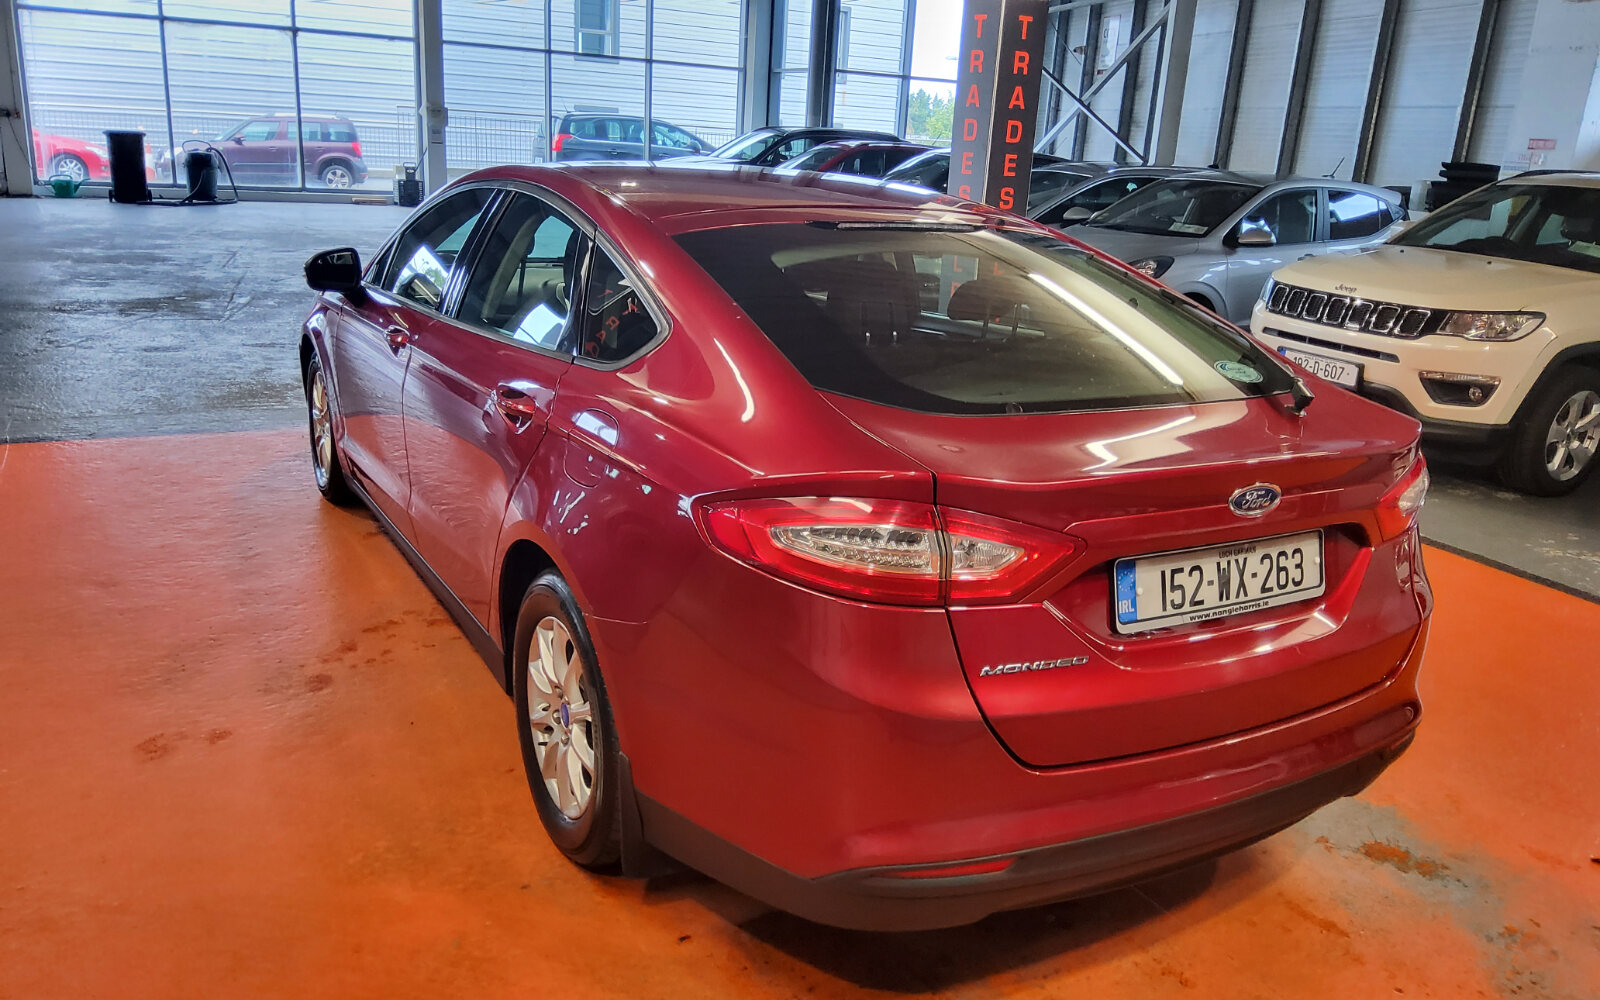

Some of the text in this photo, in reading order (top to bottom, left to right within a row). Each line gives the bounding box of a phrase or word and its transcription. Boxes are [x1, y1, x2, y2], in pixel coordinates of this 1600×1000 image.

[999, 15, 1033, 210] TRADES
[1241, 490, 1272, 510] Ford
[1160, 547, 1305, 612] 152-WX-263
[1118, 599, 1135, 614] IRL
[979, 656, 1089, 677] MONDEO
